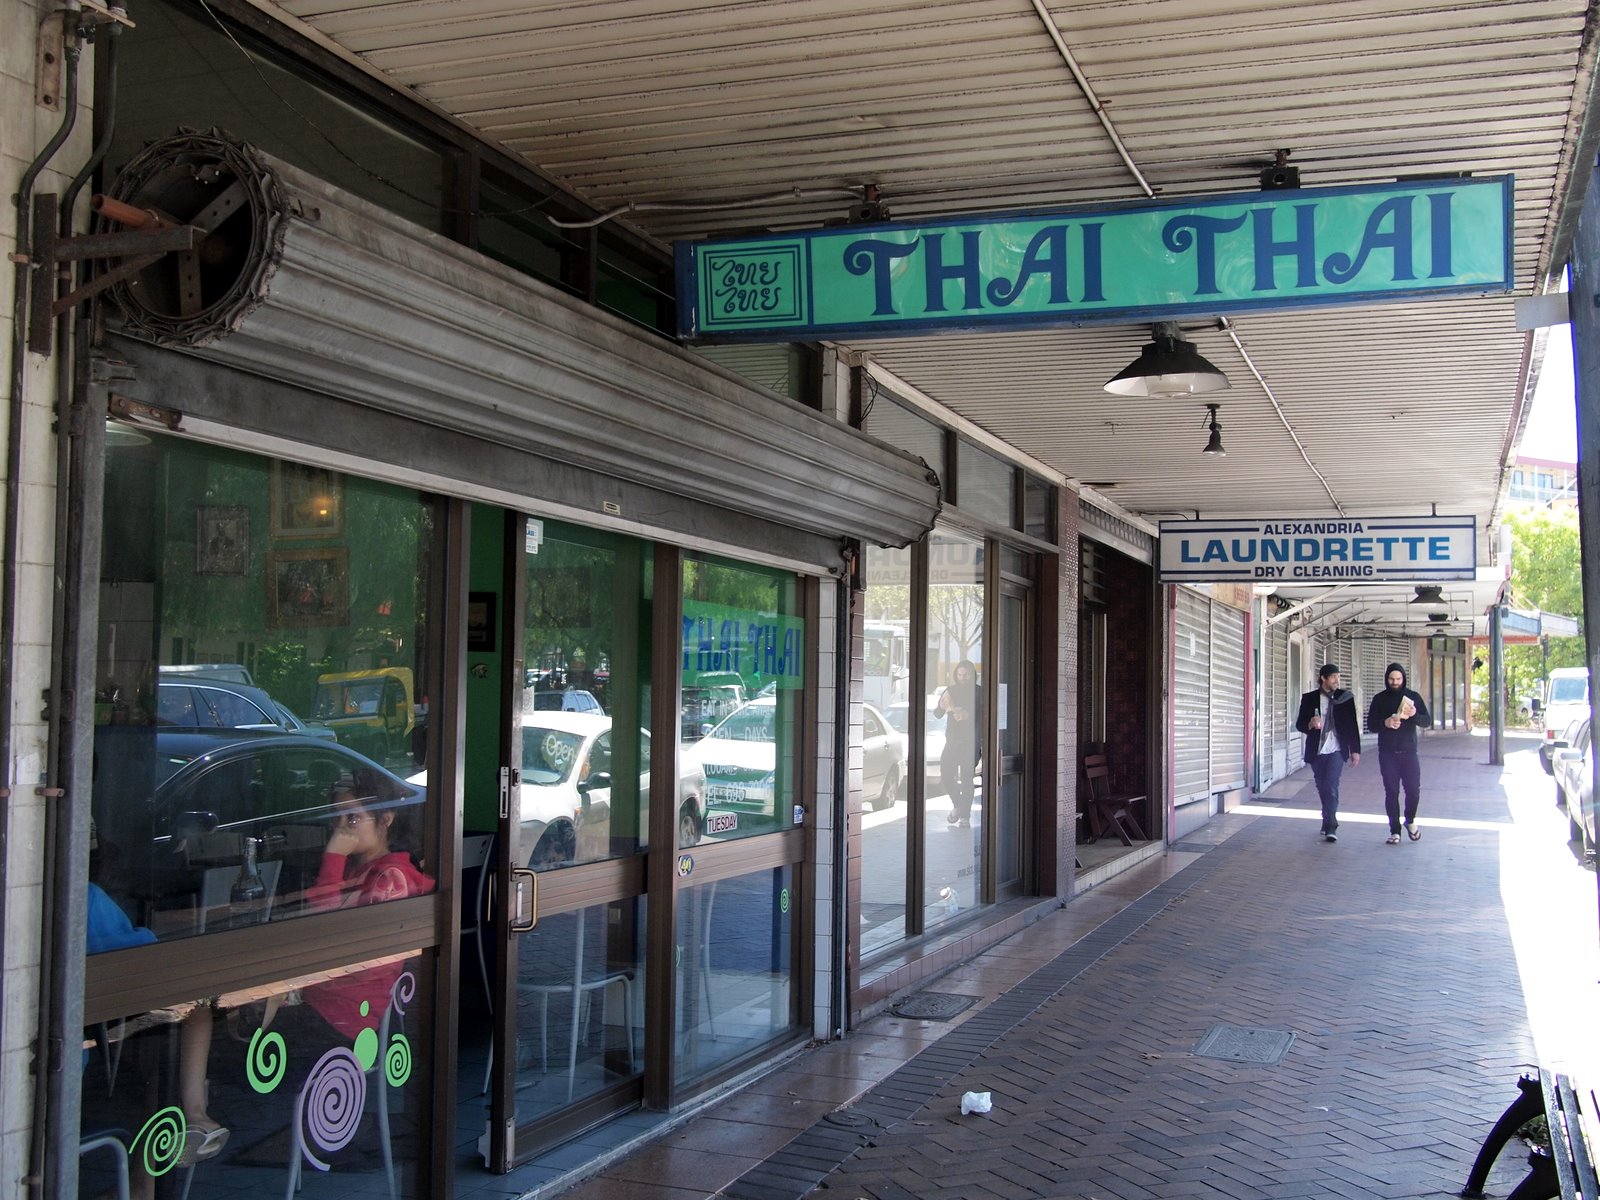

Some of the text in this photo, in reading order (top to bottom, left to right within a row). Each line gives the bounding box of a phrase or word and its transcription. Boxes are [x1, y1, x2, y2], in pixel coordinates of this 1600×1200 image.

[843, 192, 1456, 316] THAI THAI
[712, 260, 781, 287] ไทย
[715, 287, 781, 313] ไทย
[1263, 522, 1364, 535] ALEXANDRIA
[1181, 536, 1450, 563] LAUNDRETTE
[1254, 565, 1373, 577] DRY CLEANING
[683, 613, 801, 677] THAI THAI
[701, 699, 717, 717] EAT
[745, 726, 768, 742] DAYS
[546, 735, 575, 766] Open
[708, 816, 737, 833] TUESDAY
